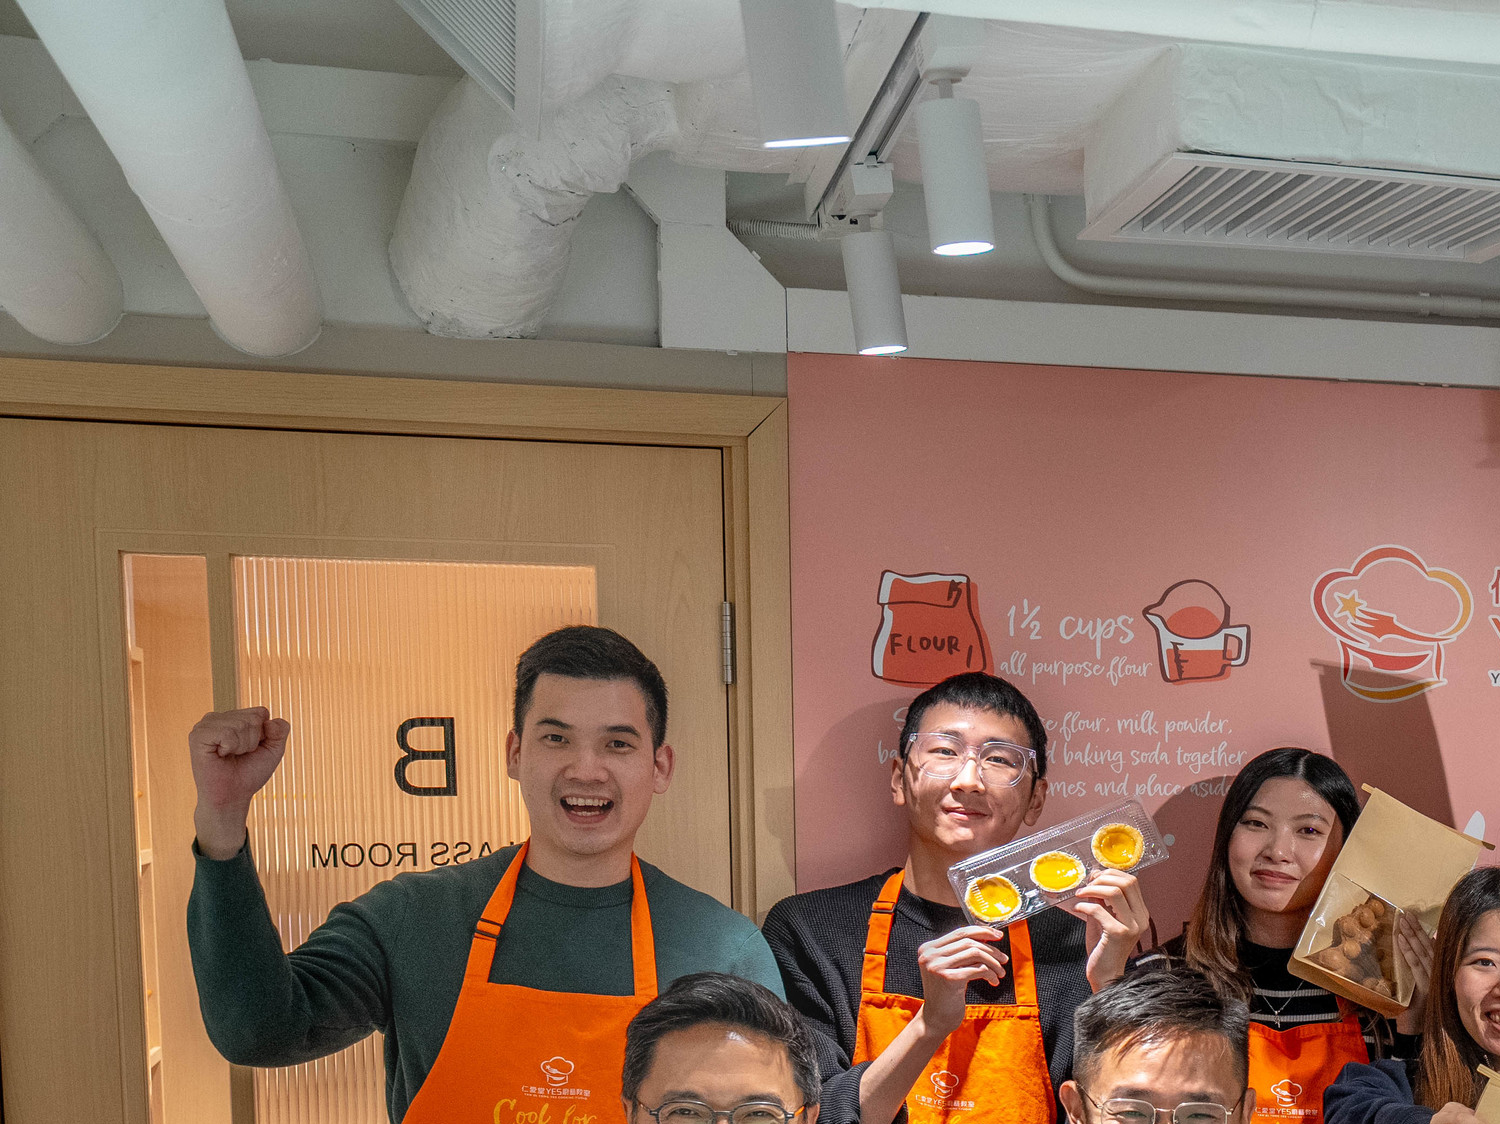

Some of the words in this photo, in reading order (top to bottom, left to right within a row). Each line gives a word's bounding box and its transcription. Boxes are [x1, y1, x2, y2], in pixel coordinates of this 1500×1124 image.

[890, 633, 960, 655] FLOUR
[1059, 615, 1135, 660] cups
[1000, 650, 1027, 676] all
[1032, 659, 1105, 686] purpose
[1106, 656, 1152, 686] flour
[1059, 711, 1110, 741] flour,
[1117, 710, 1159, 735] milk
[1165, 711, 1233, 743] powder,
[1063, 742, 1126, 773] baking
[1131, 742, 1170, 766] soda
[1176, 741, 1247, 774] together
[1094, 773, 1129, 797] and
[1135, 774, 1185, 797] place
